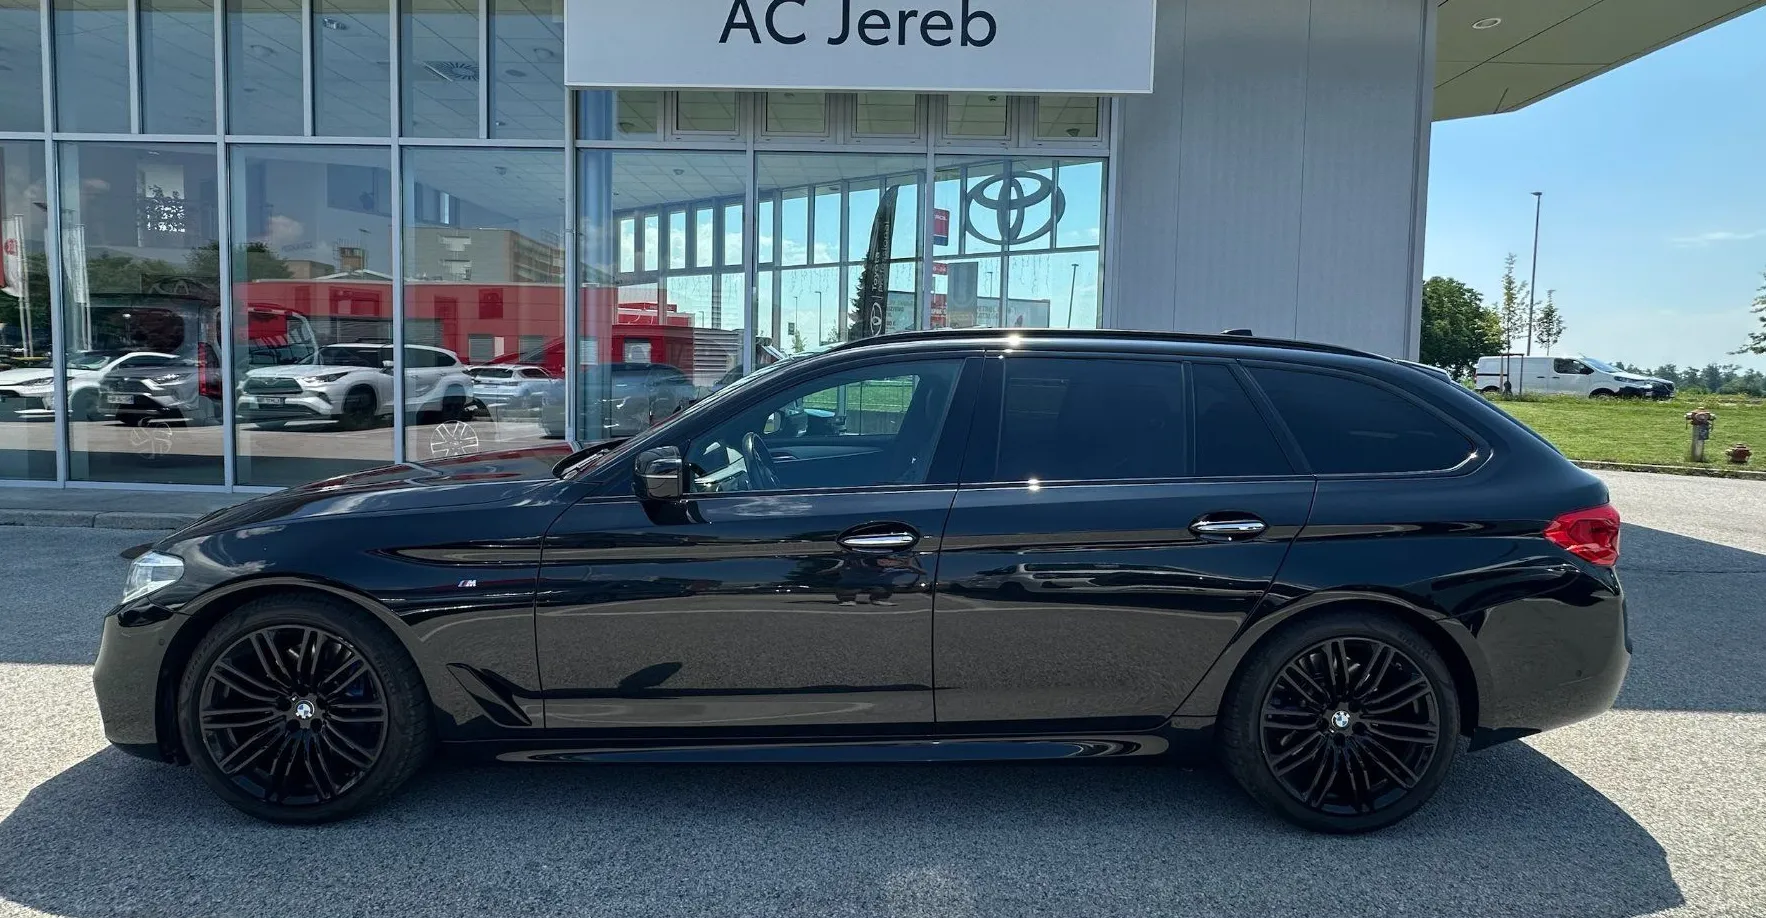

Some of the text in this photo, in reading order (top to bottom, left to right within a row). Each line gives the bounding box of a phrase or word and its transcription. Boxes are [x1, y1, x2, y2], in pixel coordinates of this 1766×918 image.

[719, 0, 997, 47] AC Jereb
[872, 251, 880, 292] Toyota
